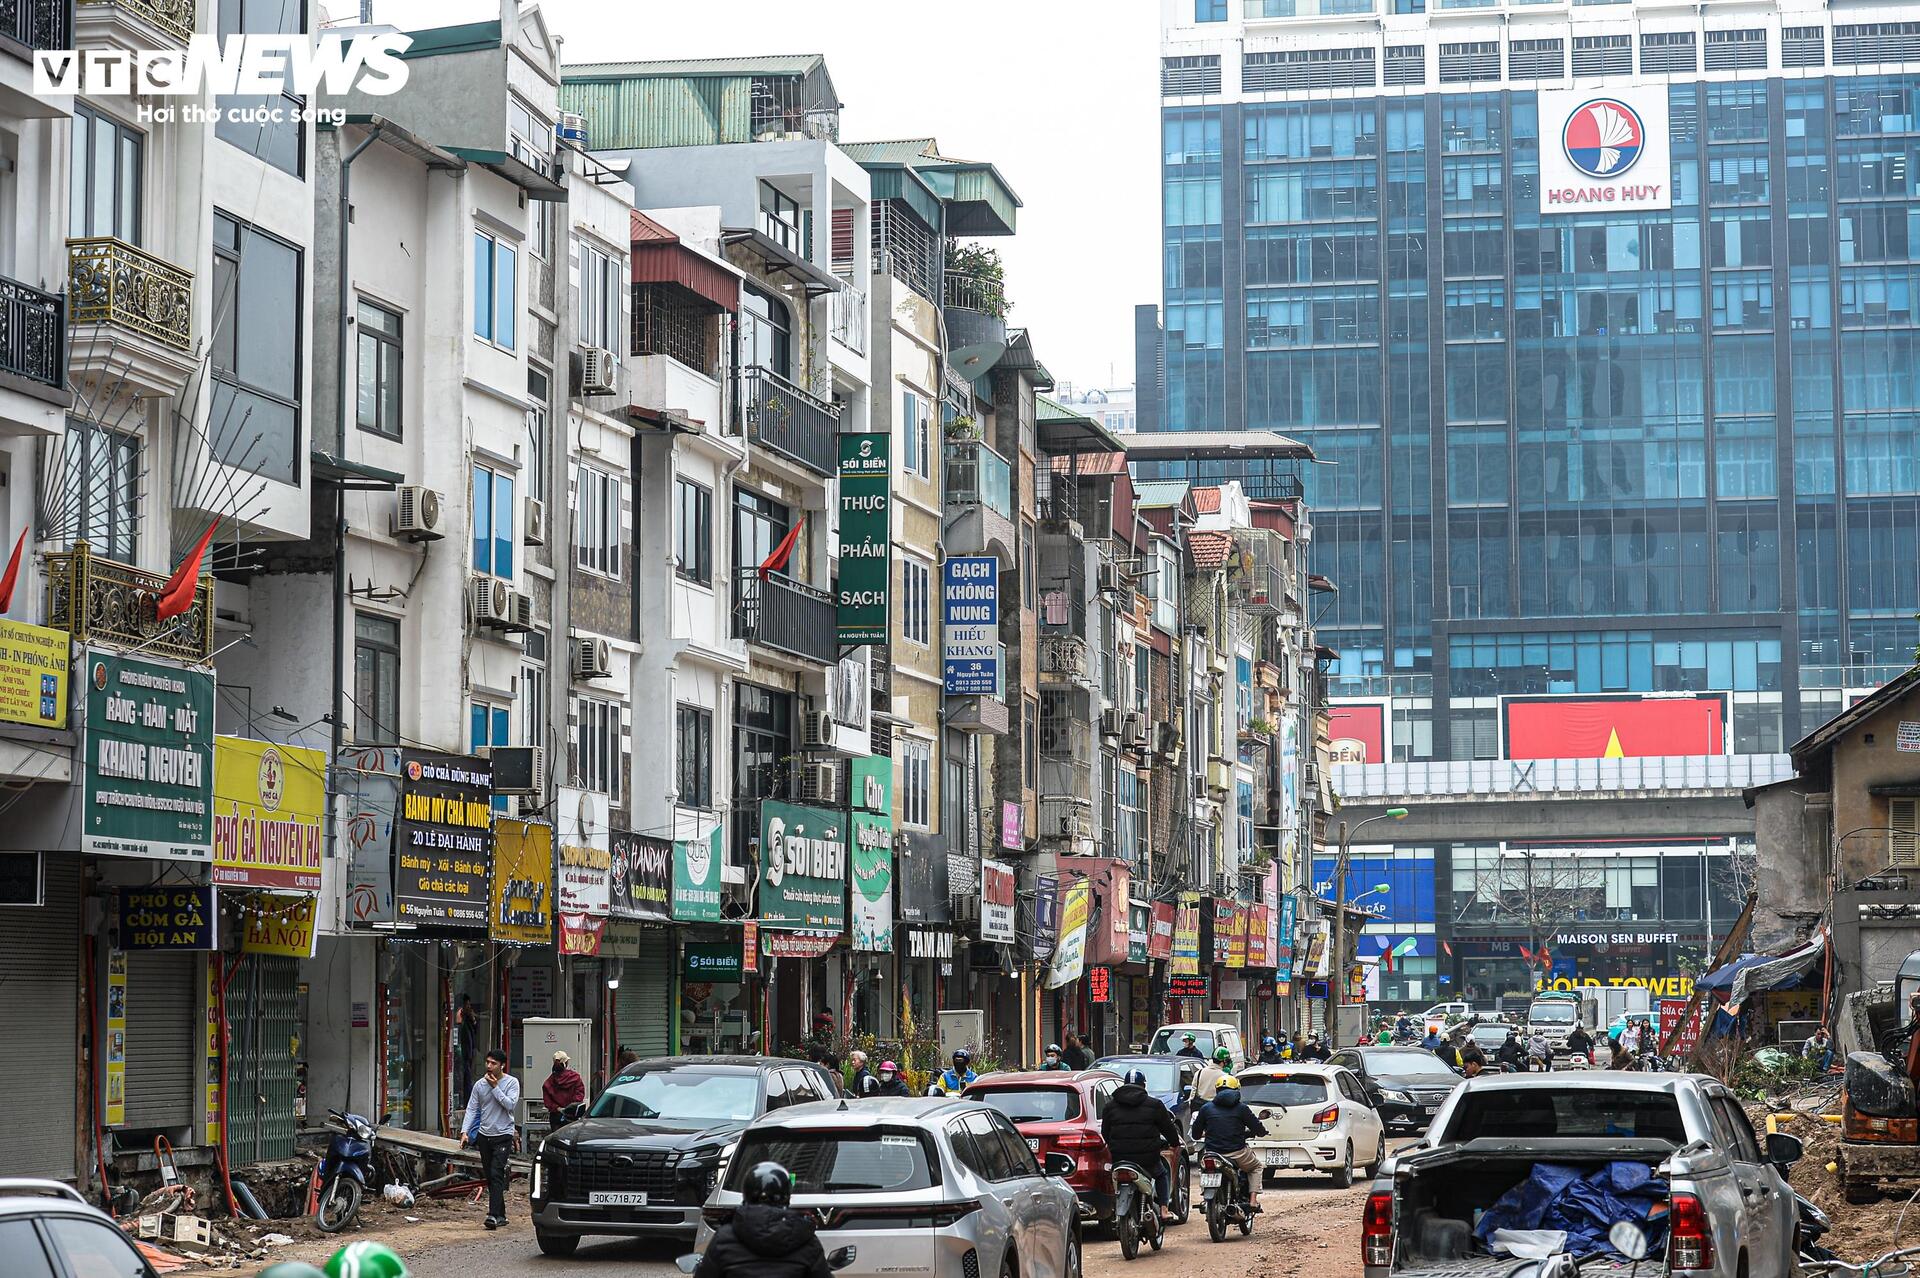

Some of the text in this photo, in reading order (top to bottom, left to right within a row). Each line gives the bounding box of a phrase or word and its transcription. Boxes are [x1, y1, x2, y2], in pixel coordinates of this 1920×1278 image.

[1548, 185, 1661, 204] HOANG HUY
[842, 456, 887, 469] SÓI BIỂN
[841, 494, 886, 514] THỰC
[840, 535, 885, 557] PHẨM
[951, 562, 990, 581] GẠCH
[840, 591, 885, 609] SẠCH
[946, 582, 995, 600] KHÔNG
[950, 605, 991, 620] NUNG
[953, 625, 986, 641] HIẾU
[23, 651, 48, 668] PHÓNG
[946, 645, 993, 656] KHANG
[970, 662, 982, 671] 36
[105, 690, 136, 724] RĂNG
[143, 697, 167, 729] HÀM
[175, 702, 198, 739] MẶT
[98, 739, 202, 788] KHANG NGUYÊN
[405, 789, 490, 829] BÁNH MỲ CHẢ NÓNG
[214, 802, 320, 868] PHỞ GÀ NGUYÊN HÀ
[413, 829, 482, 852] 20 LÊ ĐẠI HÀNH
[784, 824, 810, 877] SÓI
[810, 825, 845, 880] BIỂN
[401, 855, 419, 868] Bánh
[454, 860, 471, 874] Bánh
[418, 877, 430, 890] Giò
[444, 880, 456, 893] các
[456, 881, 469, 896] loại
[1366, 901, 1386, 913] CẤP
[174, 909, 204, 926] GÀ
[170, 931, 196, 944] AN
[248, 922, 309, 952] HÀ NỘI
[908, 923, 953, 958] TÂM AN
[1557, 933, 1679, 944] MAISON SEN BUFFET
[1491, 941, 1510, 952] MB
[700, 955, 738, 966] SÓI BIỂN
[1172, 979, 1186, 987] Phụ
[1662, 1004, 1676, 1016] SỬA
[593, 1193, 643, 1204] 30K-718.72
